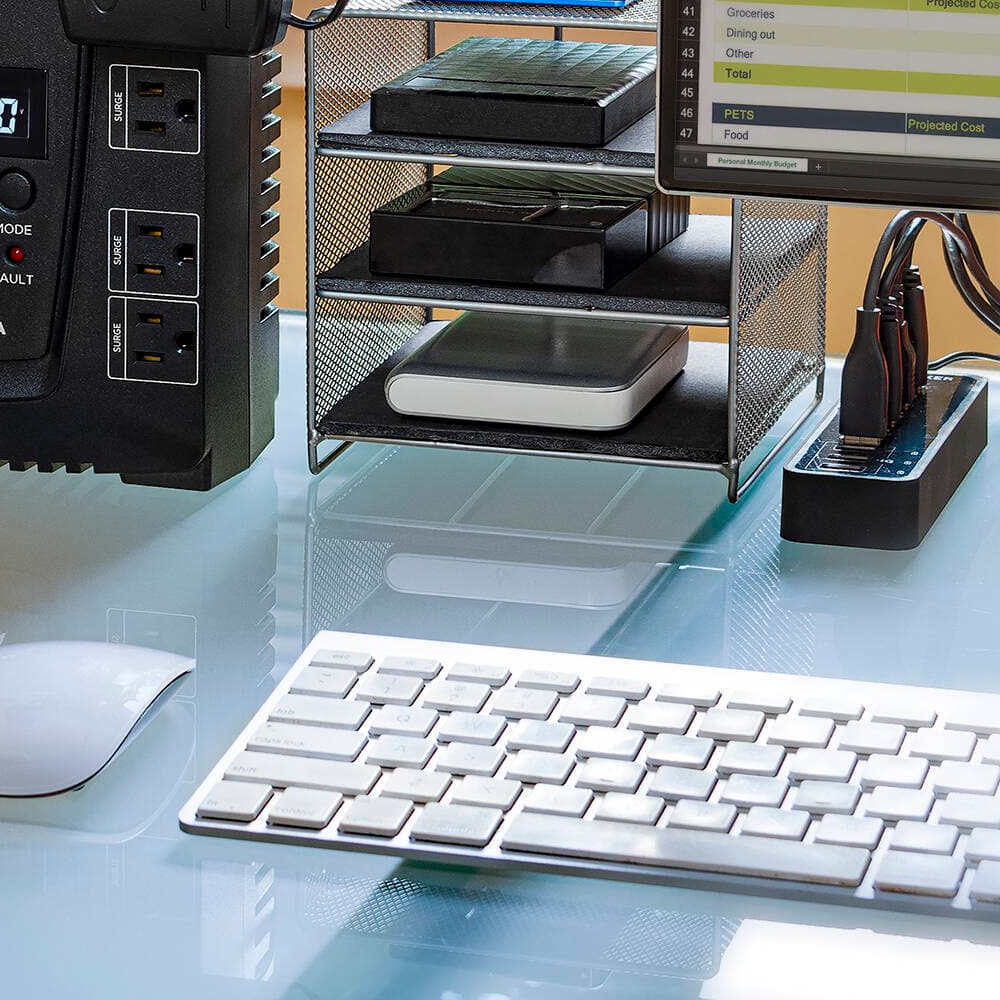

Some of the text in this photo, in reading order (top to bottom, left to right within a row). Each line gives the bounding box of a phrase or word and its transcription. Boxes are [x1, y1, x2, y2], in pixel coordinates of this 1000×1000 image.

[683, 6, 694, 16] 41
[726, 8, 775, 19] Groceries
[682, 27, 695, 36] 42
[726, 28, 776, 40] Dining out
[682, 48, 694, 58] 43
[726, 48, 754, 59] Other
[682, 68, 694, 78] 44
[726, 68, 752, 79] Total
[681, 88, 694, 98] 45
[114, 92, 123, 122] SURGE
[680, 108, 693, 118] 46
[724, 108, 754, 120] PETS
[908, 118, 985, 134] Projected Cost
[680, 128, 692, 138] 47
[724, 129, 749, 140] Food
[774, 160, 797, 169] Budget
[113, 234, 122, 265] SURGE
[112, 322, 122, 353] SURGE
